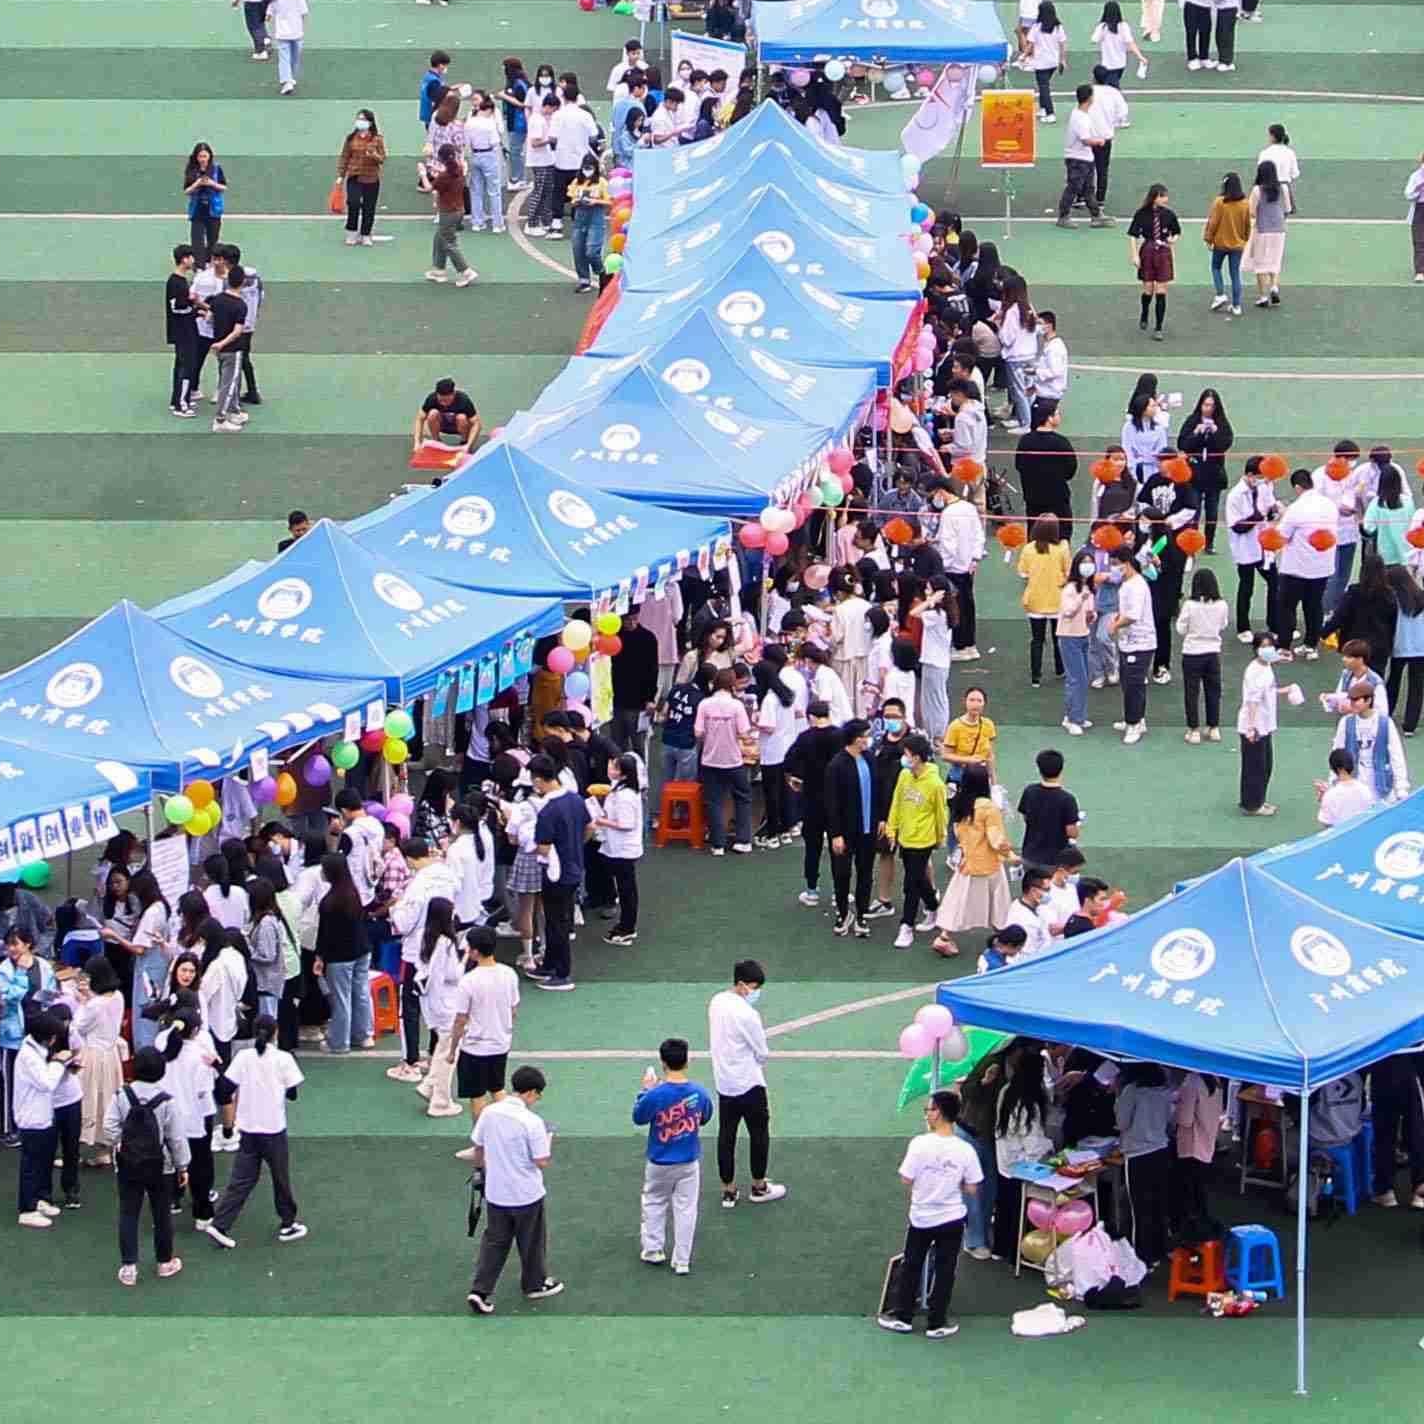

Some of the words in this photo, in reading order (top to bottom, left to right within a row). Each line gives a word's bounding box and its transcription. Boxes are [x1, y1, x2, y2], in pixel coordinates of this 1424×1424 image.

[1090, 963, 1224, 1016] 广州商学院
